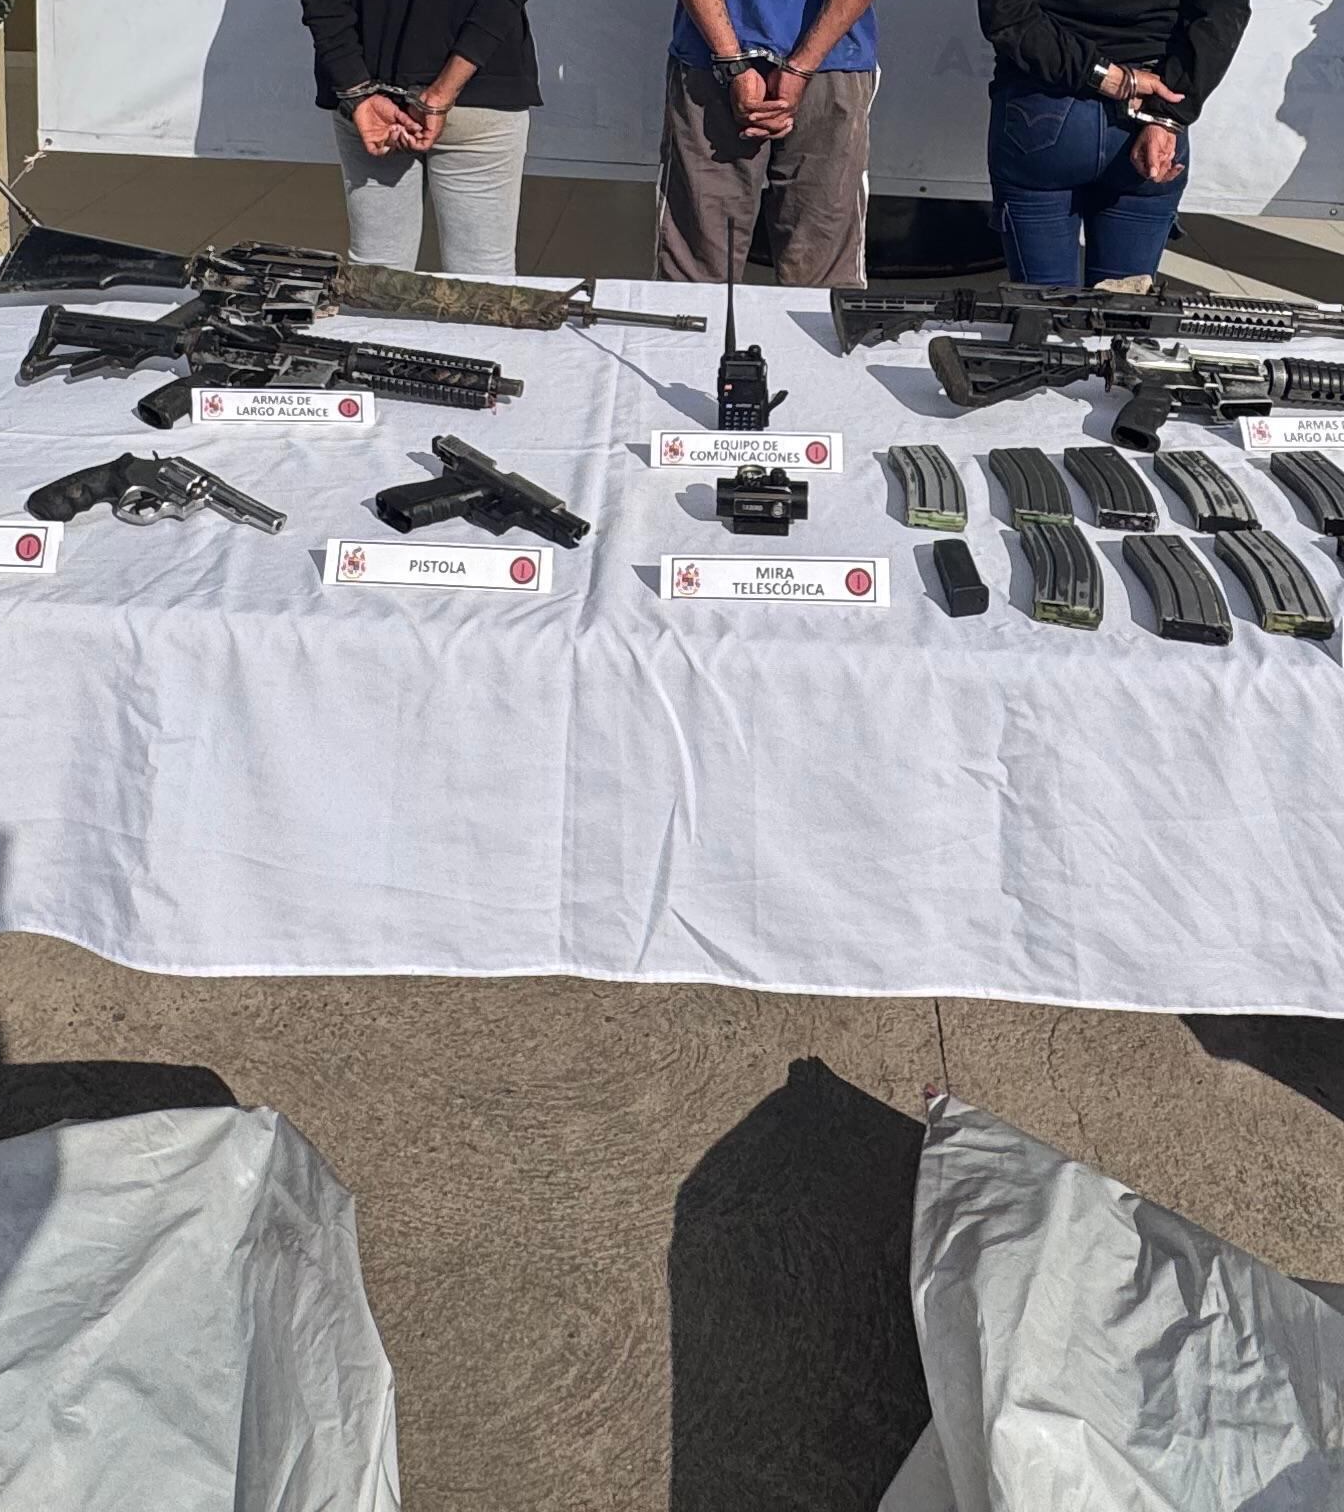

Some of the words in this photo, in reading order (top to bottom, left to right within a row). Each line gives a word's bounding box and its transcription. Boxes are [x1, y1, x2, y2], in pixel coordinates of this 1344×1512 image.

[252, 395, 294, 405] ARMAS
[297, 396, 311, 405] DE
[236, 406, 275, 416] LARGO
[277, 407, 329, 417] ALCANCE
[1298, 420, 1339, 430] ARMAS
[1284, 432, 1322, 442] LARGO
[713, 438, 760, 453] EQUIPO
[762, 439, 779, 452] DE
[689, 450, 800, 464] COMUNICACIONES
[409, 560, 466, 574] PISTOLA
[755, 566, 795, 580] MIRA
[732, 579, 825, 596] TELESCÓPICA
